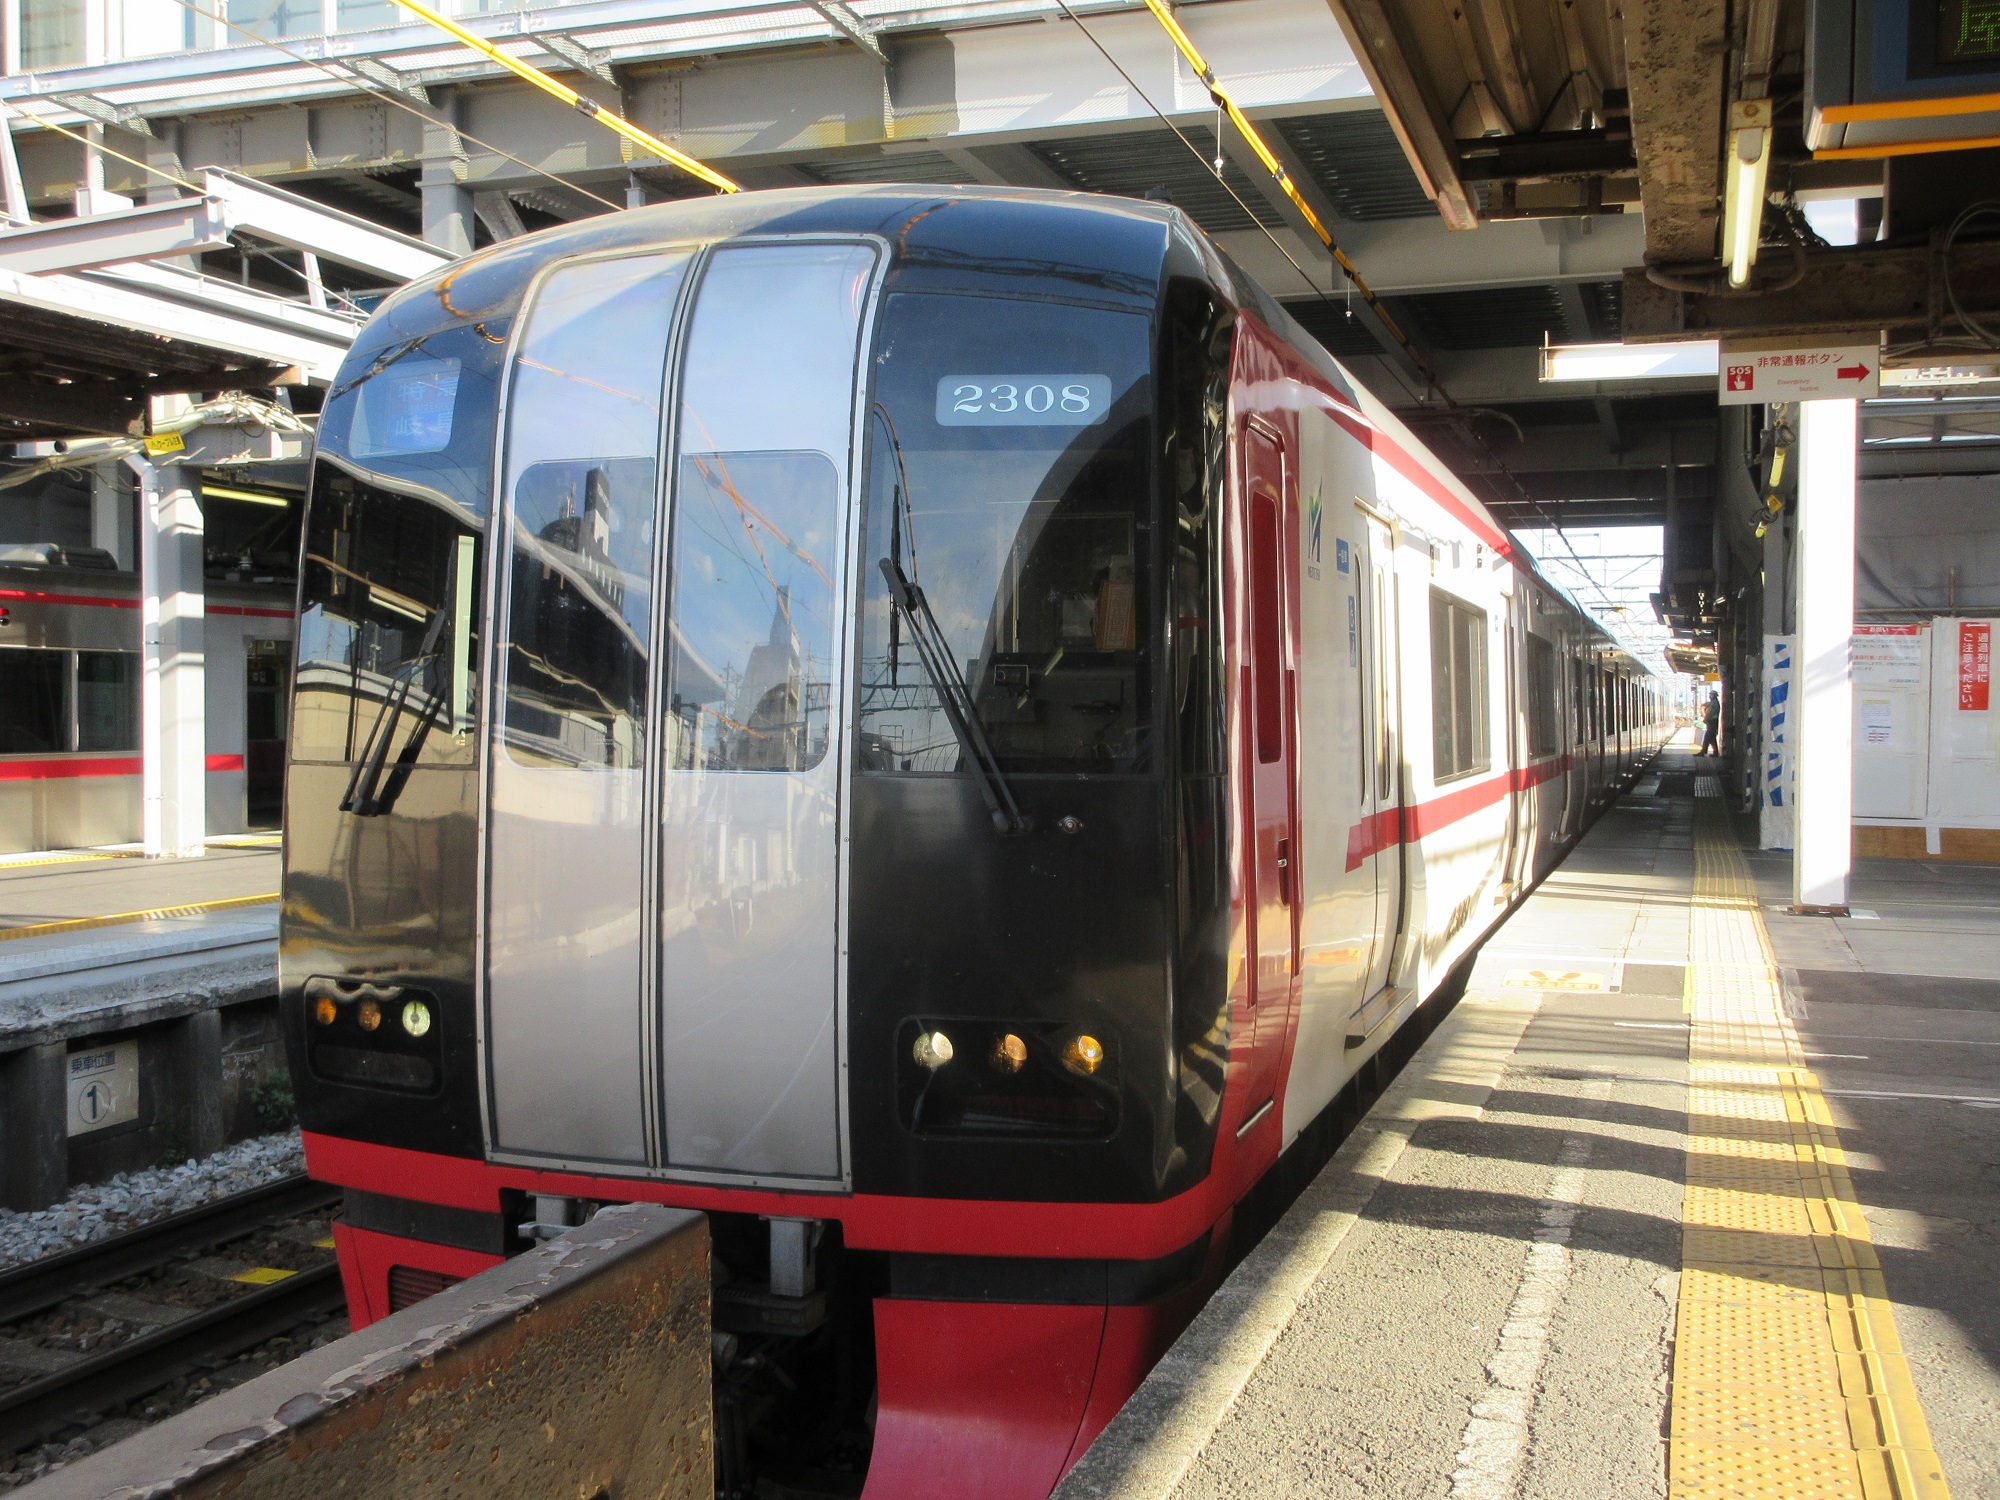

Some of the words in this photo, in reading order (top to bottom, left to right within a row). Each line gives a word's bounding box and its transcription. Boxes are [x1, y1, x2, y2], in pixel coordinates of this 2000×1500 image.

[1729, 366, 1751, 376] SOS
[1757, 353, 1844, 368] 非常通報ボタン
[1776, 378, 1810, 386] Emergency
[953, 384, 1091, 413] 2308
[1977, 632, 1989, 683] 通過列車に
[1962, 633, 1974, 708] ご注意ください。
